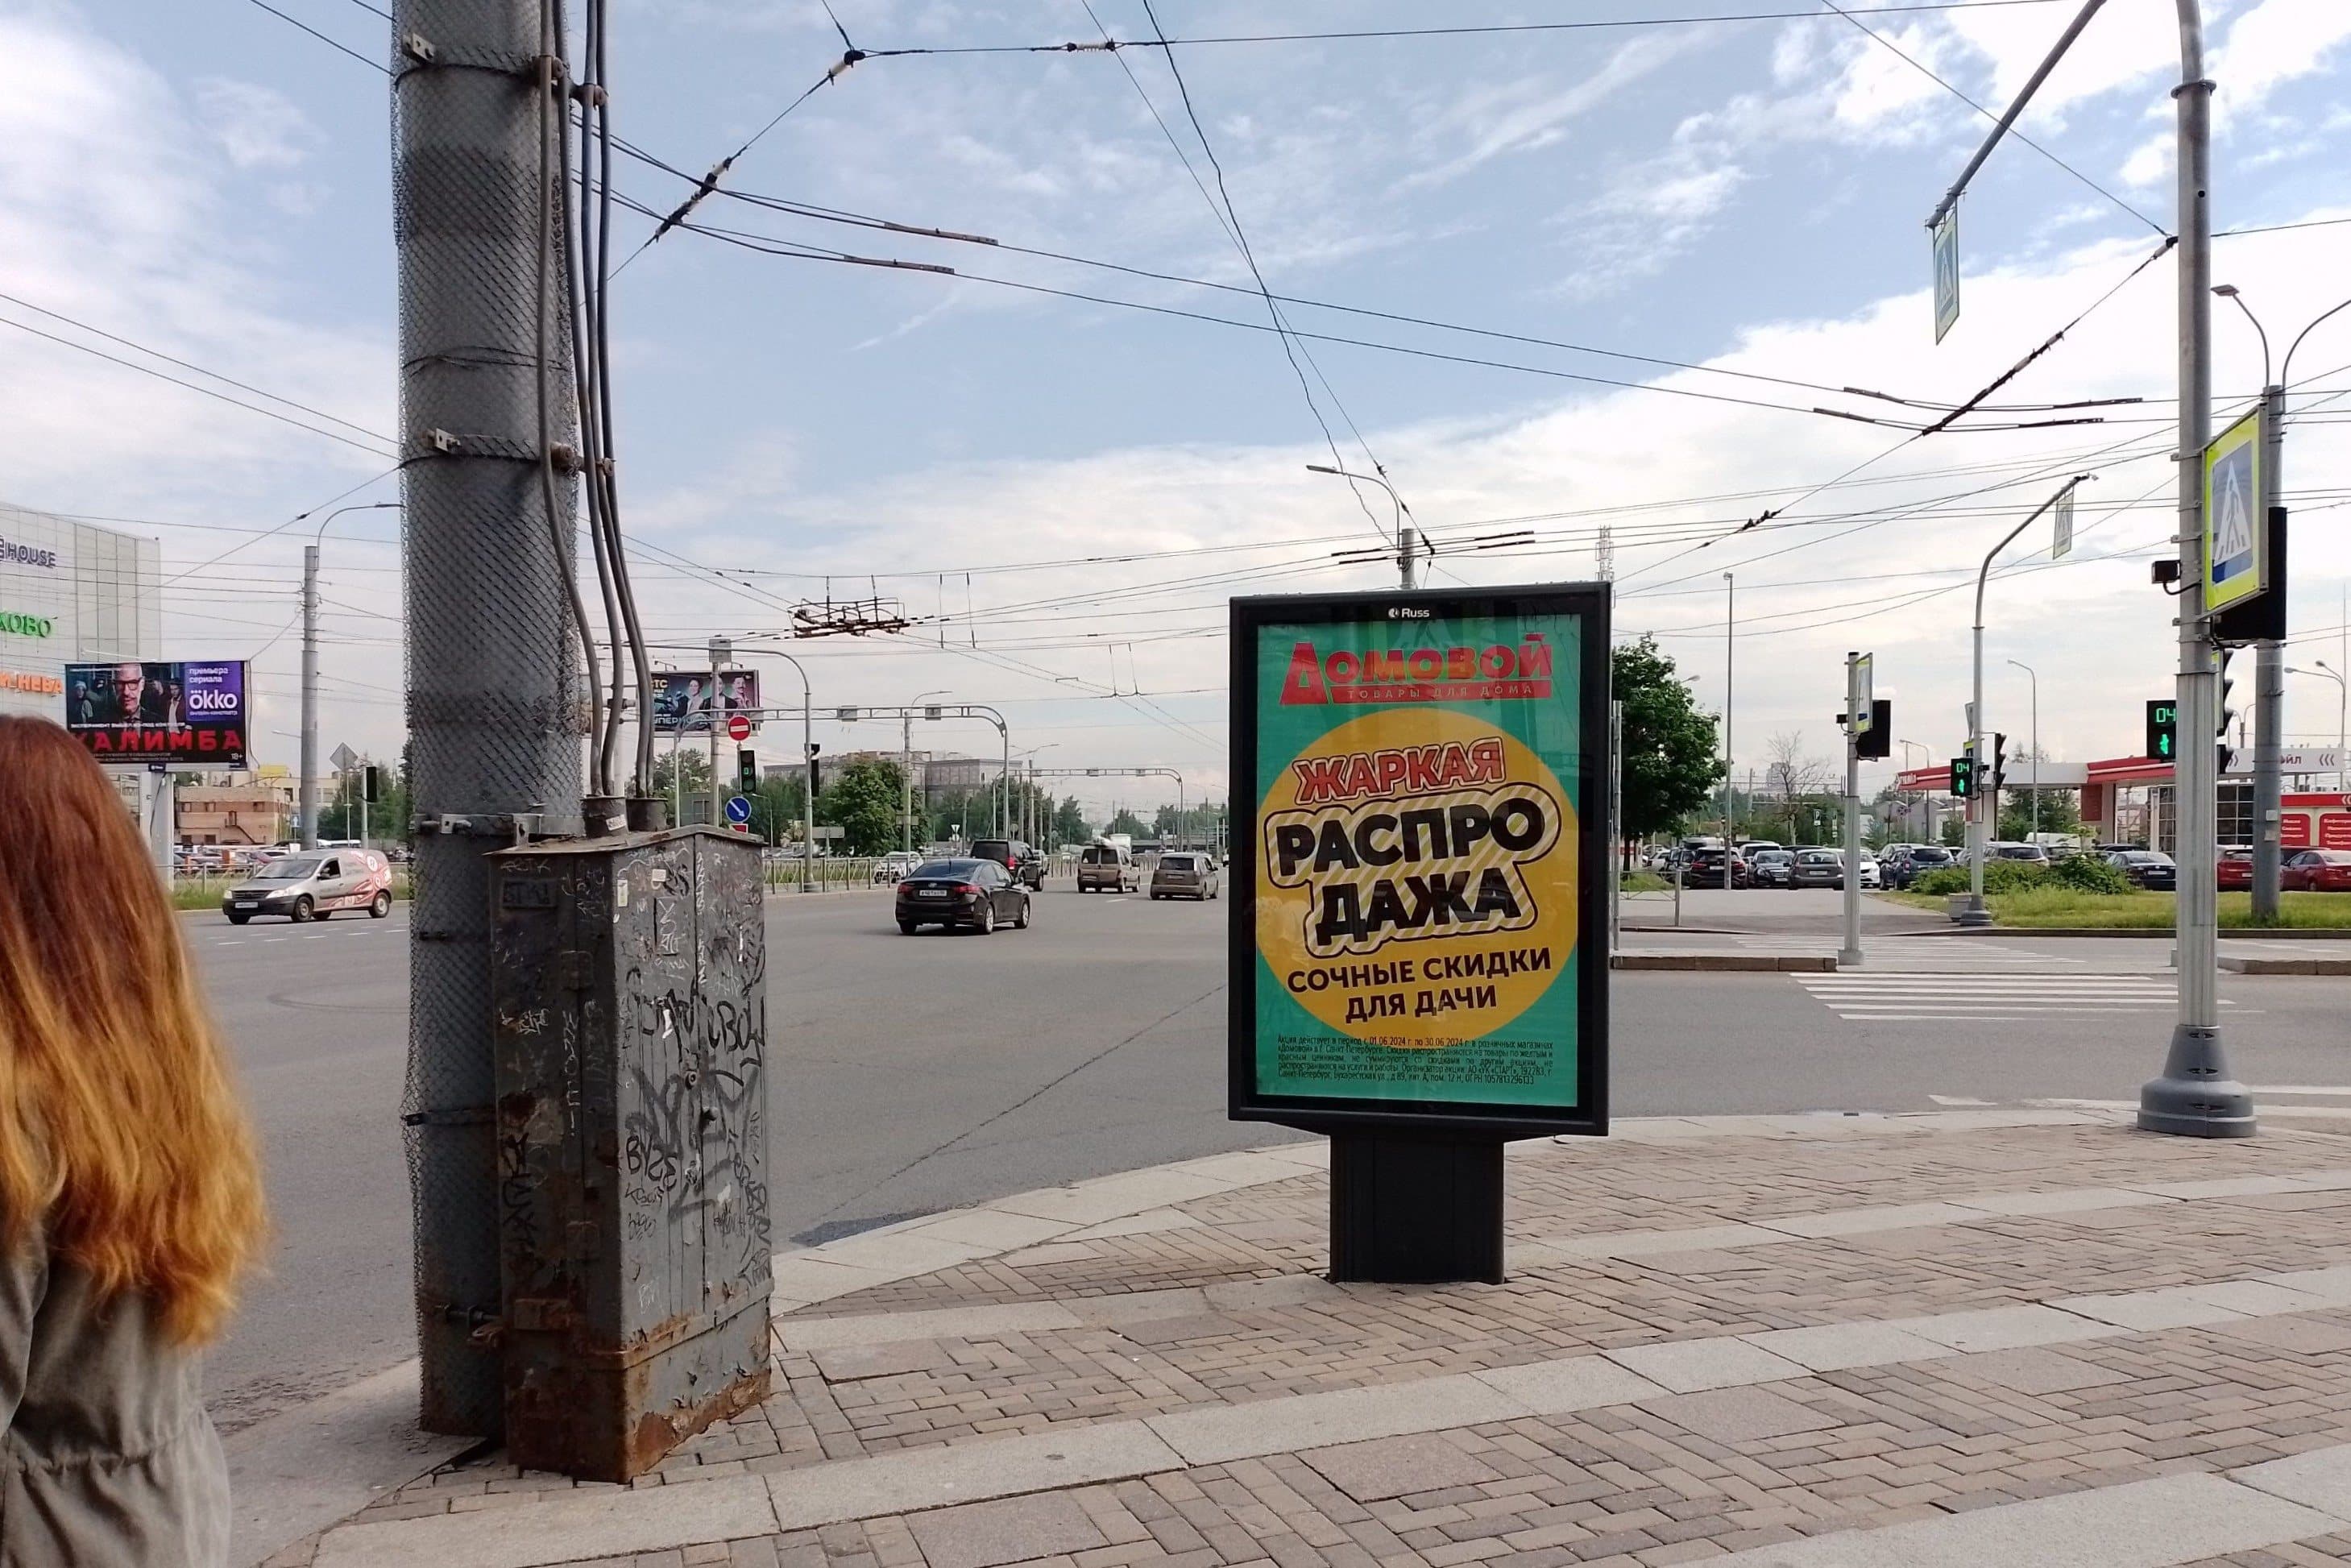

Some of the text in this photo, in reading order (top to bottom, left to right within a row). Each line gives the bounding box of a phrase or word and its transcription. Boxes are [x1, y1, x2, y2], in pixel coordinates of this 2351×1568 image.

[7, 542, 56, 566] HOUSE
[1401, 608, 1429, 619] Russ
[189, 667, 229, 675] премьера
[189, 676, 223, 685] сериала
[18, 674, 63, 693] НЕВА
[1348, 684, 1532, 700] ТОВАРЫ ДЛЯ ДОМА
[1295, 739, 1505, 803] ЖАРКАЯ
[1956, 762, 1970, 774] 04
[1276, 798, 1545, 876] РАСПРО
[1316, 867, 1521, 946] ДАЖА
[1288, 947, 1552, 993] СОЧНЫЕ СКИДКИ
[1345, 985, 1498, 1024] ДЛЯ ДАЧИ
[1415, 1038, 1423, 1046] по
